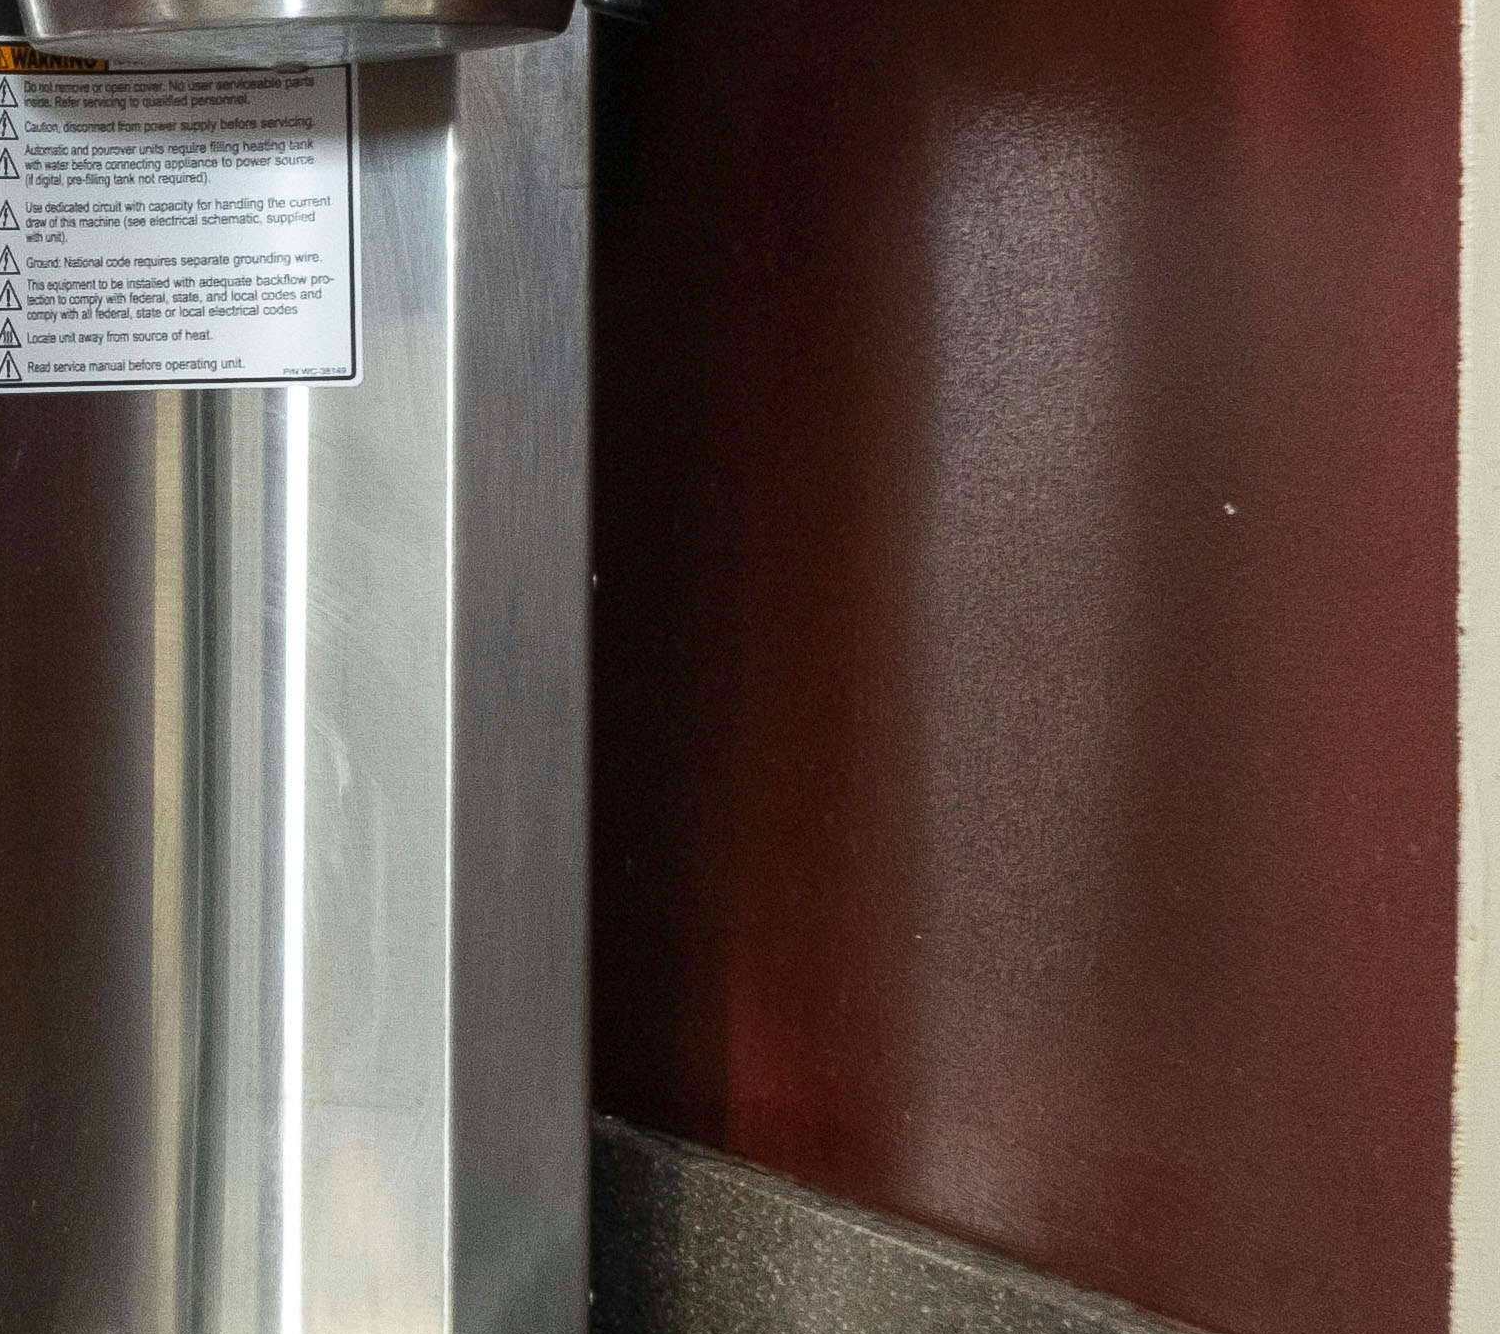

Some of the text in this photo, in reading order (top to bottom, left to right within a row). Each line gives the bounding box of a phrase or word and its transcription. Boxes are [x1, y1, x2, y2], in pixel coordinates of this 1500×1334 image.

[63, 120, 114, 132] disconnect
[117, 120, 141, 132] from
[144, 121, 176, 134] power
[180, 120, 216, 133] supply
[220, 118, 257, 130] before
[71, 144, 88, 155] and
[139, 145, 164, 155] units
[168, 143, 206, 155] require
[210, 141, 239, 155] filling
[242, 140, 285, 154] heating
[289, 139, 314, 151] tank
[72, 159, 102, 170] before
[105, 159, 160, 172] connecting
[164, 158, 217, 171] appliance
[222, 157, 232, 167] to
[236, 158, 271, 169] power
[274, 155, 315, 166] source
[25, 196, 331, 213] Use dedicated circuit with capacity for handling the current
[50, 217, 58, 228] of
[60, 217, 76, 228] this
[79, 217, 120, 227] machine
[123, 216, 146, 229] (see
[149, 214, 197, 226] electrical
[266, 210, 316, 224] supplied
[105, 256, 131, 267] code
[134, 256, 177, 269] requires
[181, 254, 229, 267] separate
[233, 252, 291, 267] grounding
[27, 274, 335, 292] This equipment to be installed with adequate backflow pro-
[58, 295, 66, 305] to
[69, 293, 103, 307] comply
[206, 290, 227, 302] and
[231, 289, 257, 301] local
[261, 289, 297, 301] codes
[300, 288, 322, 299] and
[26, 310, 57, 322] comply
[60, 309, 78, 320] with
[82, 308, 92, 319] all
[136, 307, 161, 318] state
[165, 309, 176, 318] or
[179, 305, 205, 317] local
[208, 304, 259, 316] electrical
[263, 304, 298, 315] codes
[27, 332, 56, 344] Locate
[59, 332, 76, 343] unit
[78, 334, 104, 345] away
[106, 331, 129, 342] from
[133, 331, 168, 342] source
[171, 329, 182, 341] of
[27, 361, 50, 373] Read
[53, 362, 86, 373] service
[89, 361, 125, 372] manual
[128, 359, 161, 371] before
[165, 358, 217, 372] operating
